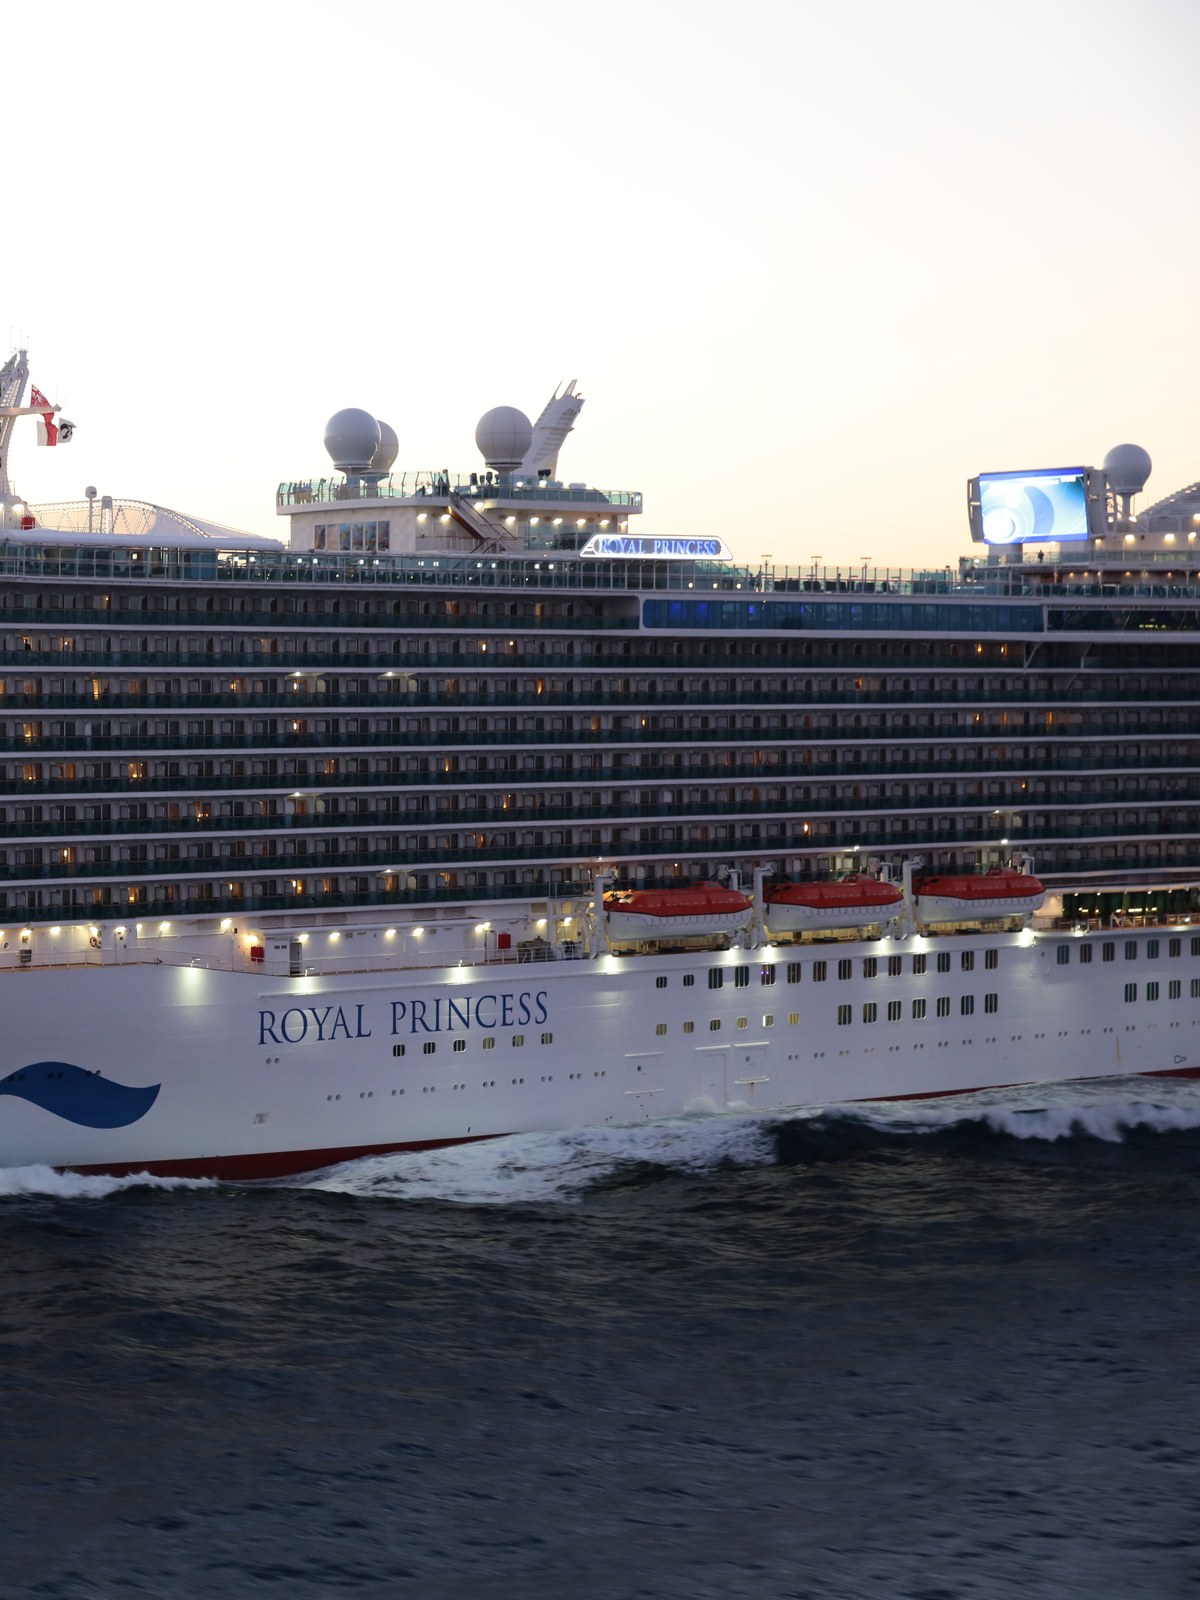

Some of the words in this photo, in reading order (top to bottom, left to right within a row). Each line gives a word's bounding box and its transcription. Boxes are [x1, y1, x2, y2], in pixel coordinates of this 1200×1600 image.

[599, 539, 646, 554] ROYAL
[653, 540, 716, 555] PRINCESS
[257, 1004, 372, 1045] ROYAL
[390, 991, 549, 1035] PRINCESS
